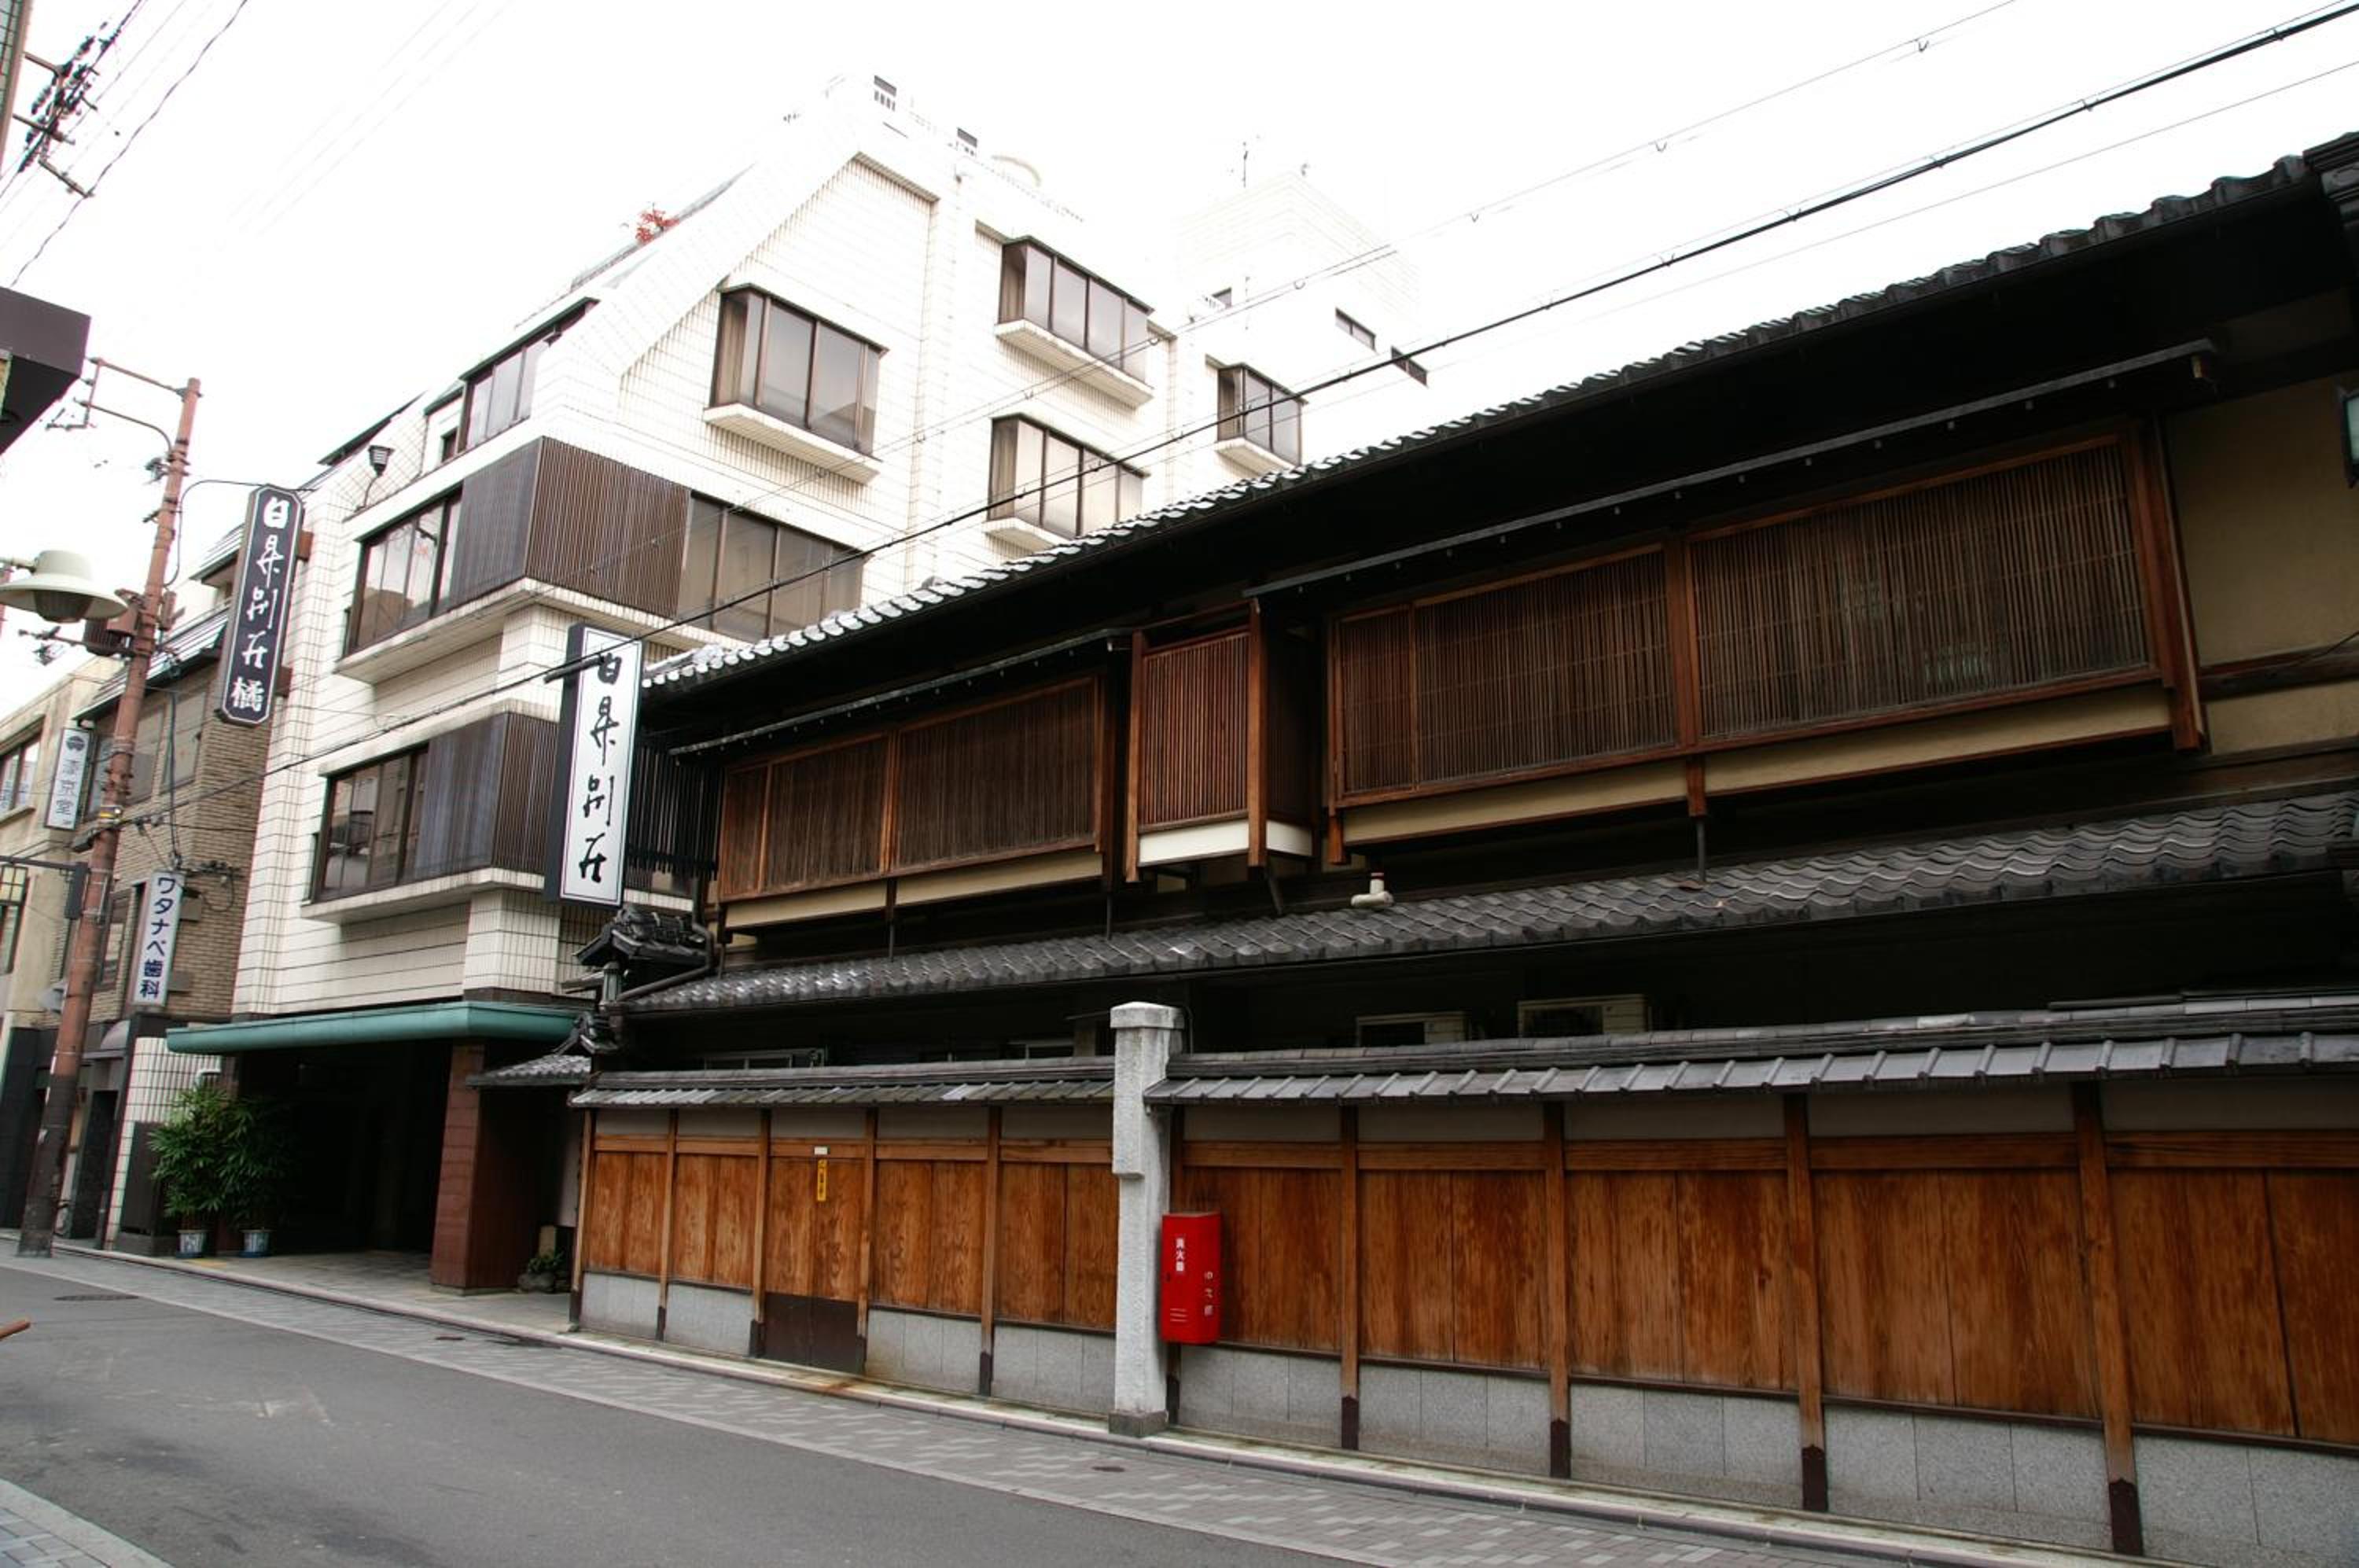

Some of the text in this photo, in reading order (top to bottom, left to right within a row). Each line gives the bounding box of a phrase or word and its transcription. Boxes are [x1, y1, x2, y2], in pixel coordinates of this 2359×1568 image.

[140, 877, 176, 998] ワタナベ歯科
